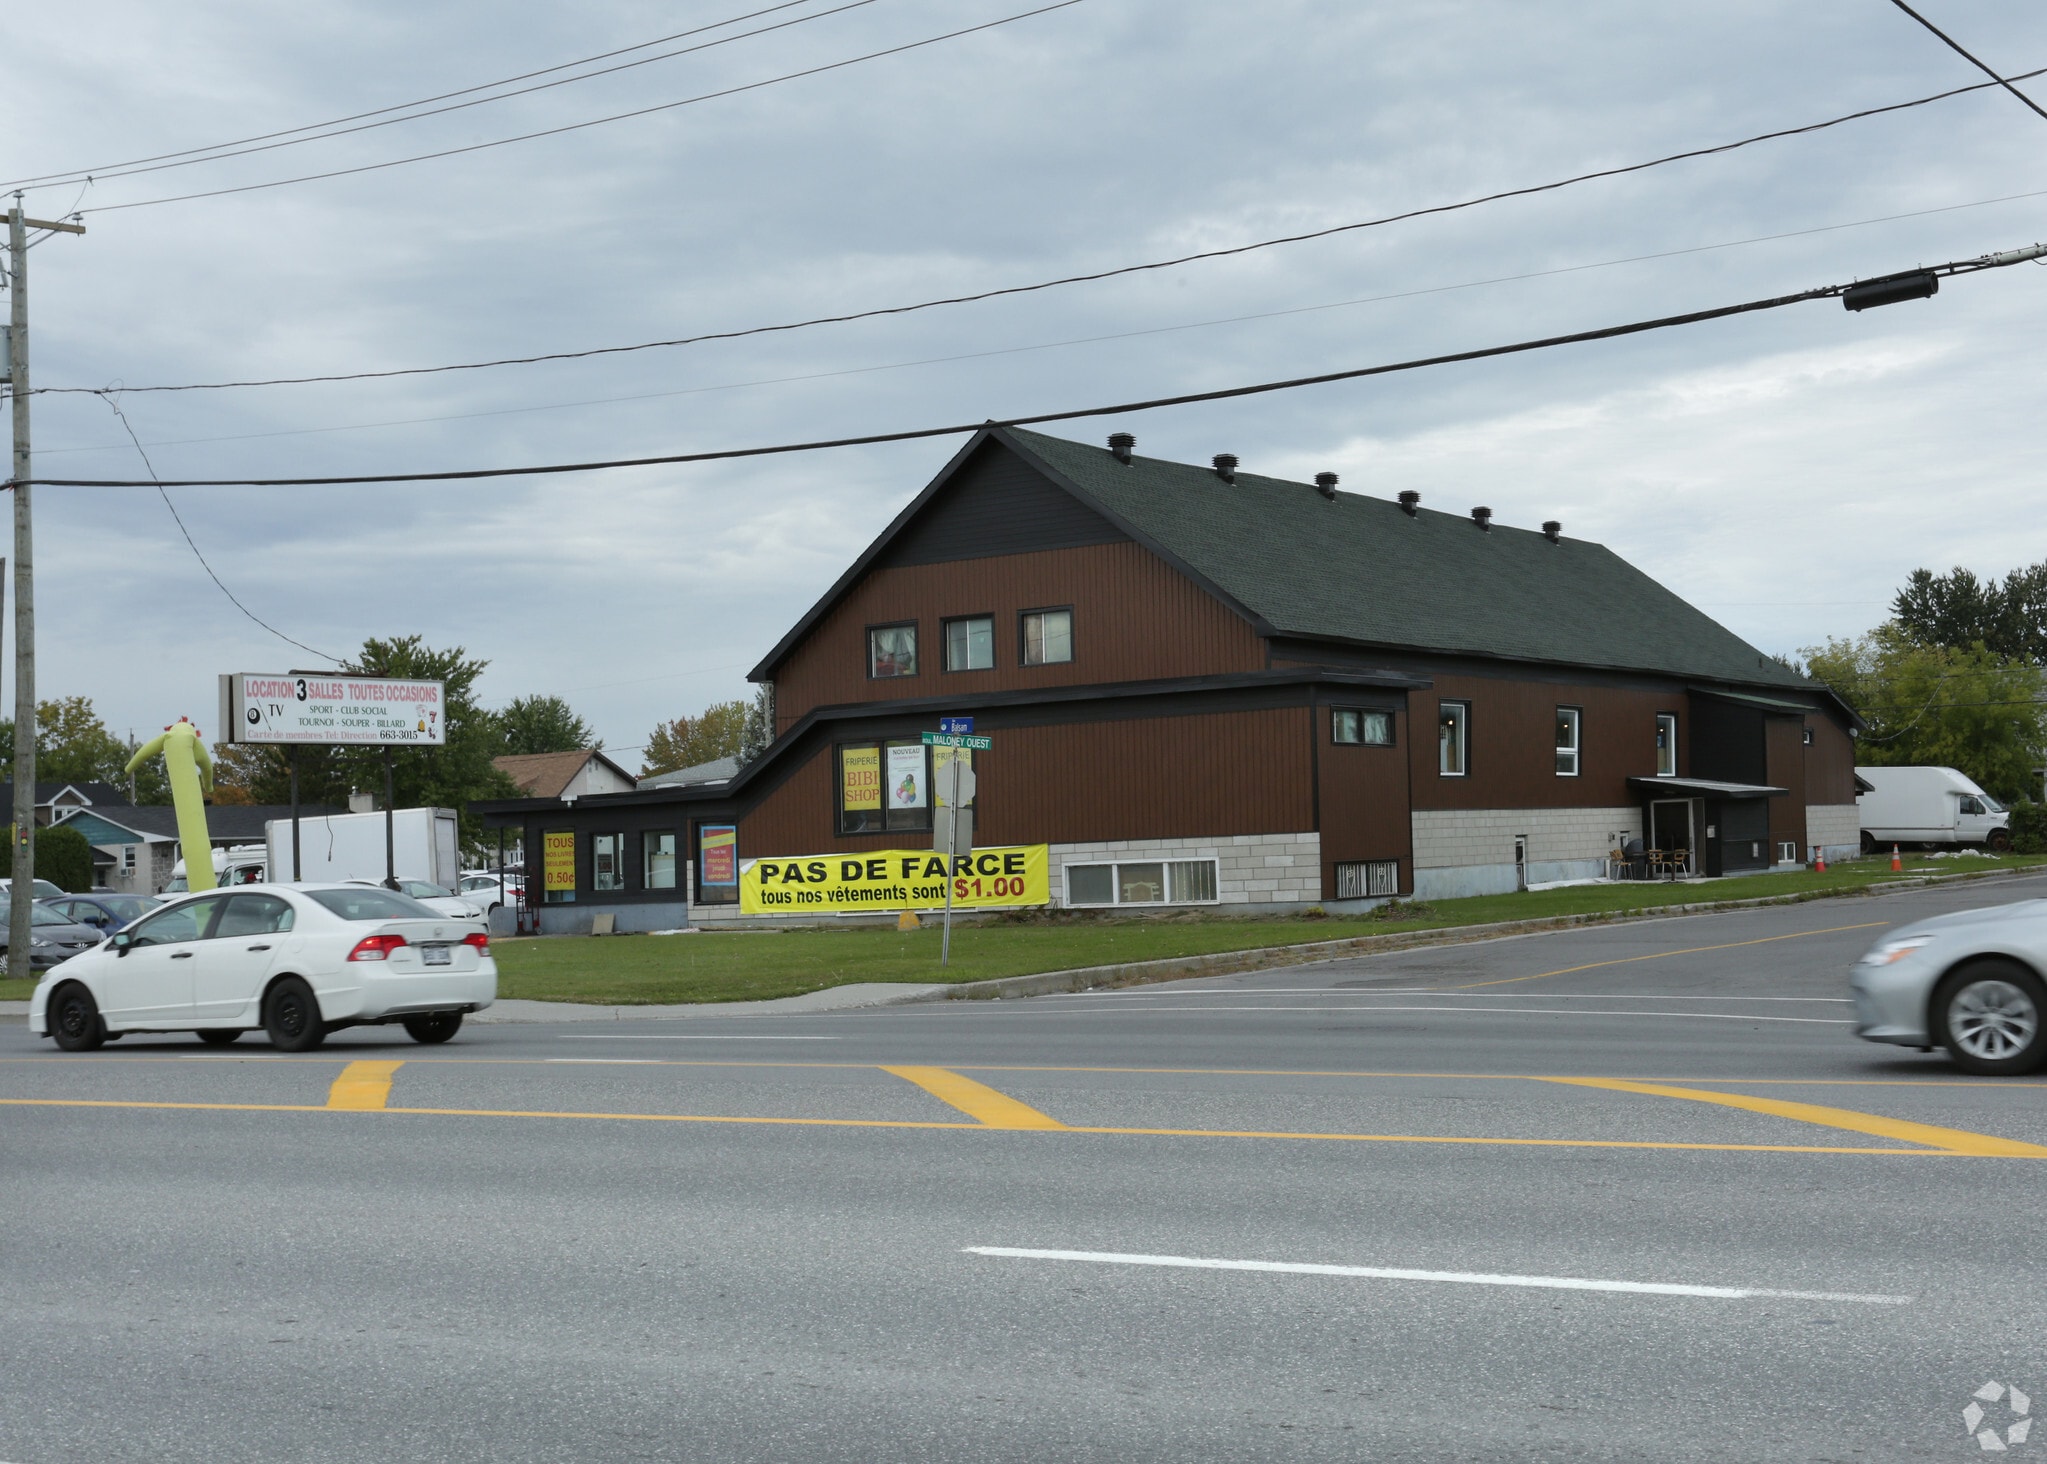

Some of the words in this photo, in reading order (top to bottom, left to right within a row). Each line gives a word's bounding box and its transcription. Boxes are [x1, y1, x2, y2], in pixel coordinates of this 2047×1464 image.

[246, 680, 294, 698] LOCATION
[296, 679, 307, 701] 3
[308, 682, 343, 700] SALLES
[348, 684, 384, 700] TOUTES
[386, 685, 437, 702] OCCASIONS
[268, 704, 284, 716] TV
[310, 705, 333, 713] SPORT
[341, 706, 359, 714] CLUB
[362, 706, 387, 715] SOCIAL
[298, 718, 334, 726] TOURNOI
[342, 719, 370, 727] SOUPER
[248, 730, 272, 738] Carte
[286, 731, 322, 739] membres
[341, 731, 377, 739] Direction
[380, 730, 418, 740] 663-3015
[933, 735, 965, 747] MALONEY
[967, 738, 990, 748] OUEST
[846, 756, 878, 766] FRIPERIE
[936, 751, 970, 760] FRIPRIE
[847, 770, 878, 786] BIBI
[846, 789, 879, 802] SHOP
[547, 837, 574, 848] TOUS
[760, 862, 828, 884] PAS
[841, 859, 887, 881] DE
[901, 853, 1025, 879] FARCE
[547, 872, 574, 884] 0.50¢
[761, 889, 792, 905] tous
[797, 890, 822, 903] nos
[828, 885, 906, 902] vêtements
[912, 886, 946, 899] sont
[955, 877, 1024, 900] $1.00
